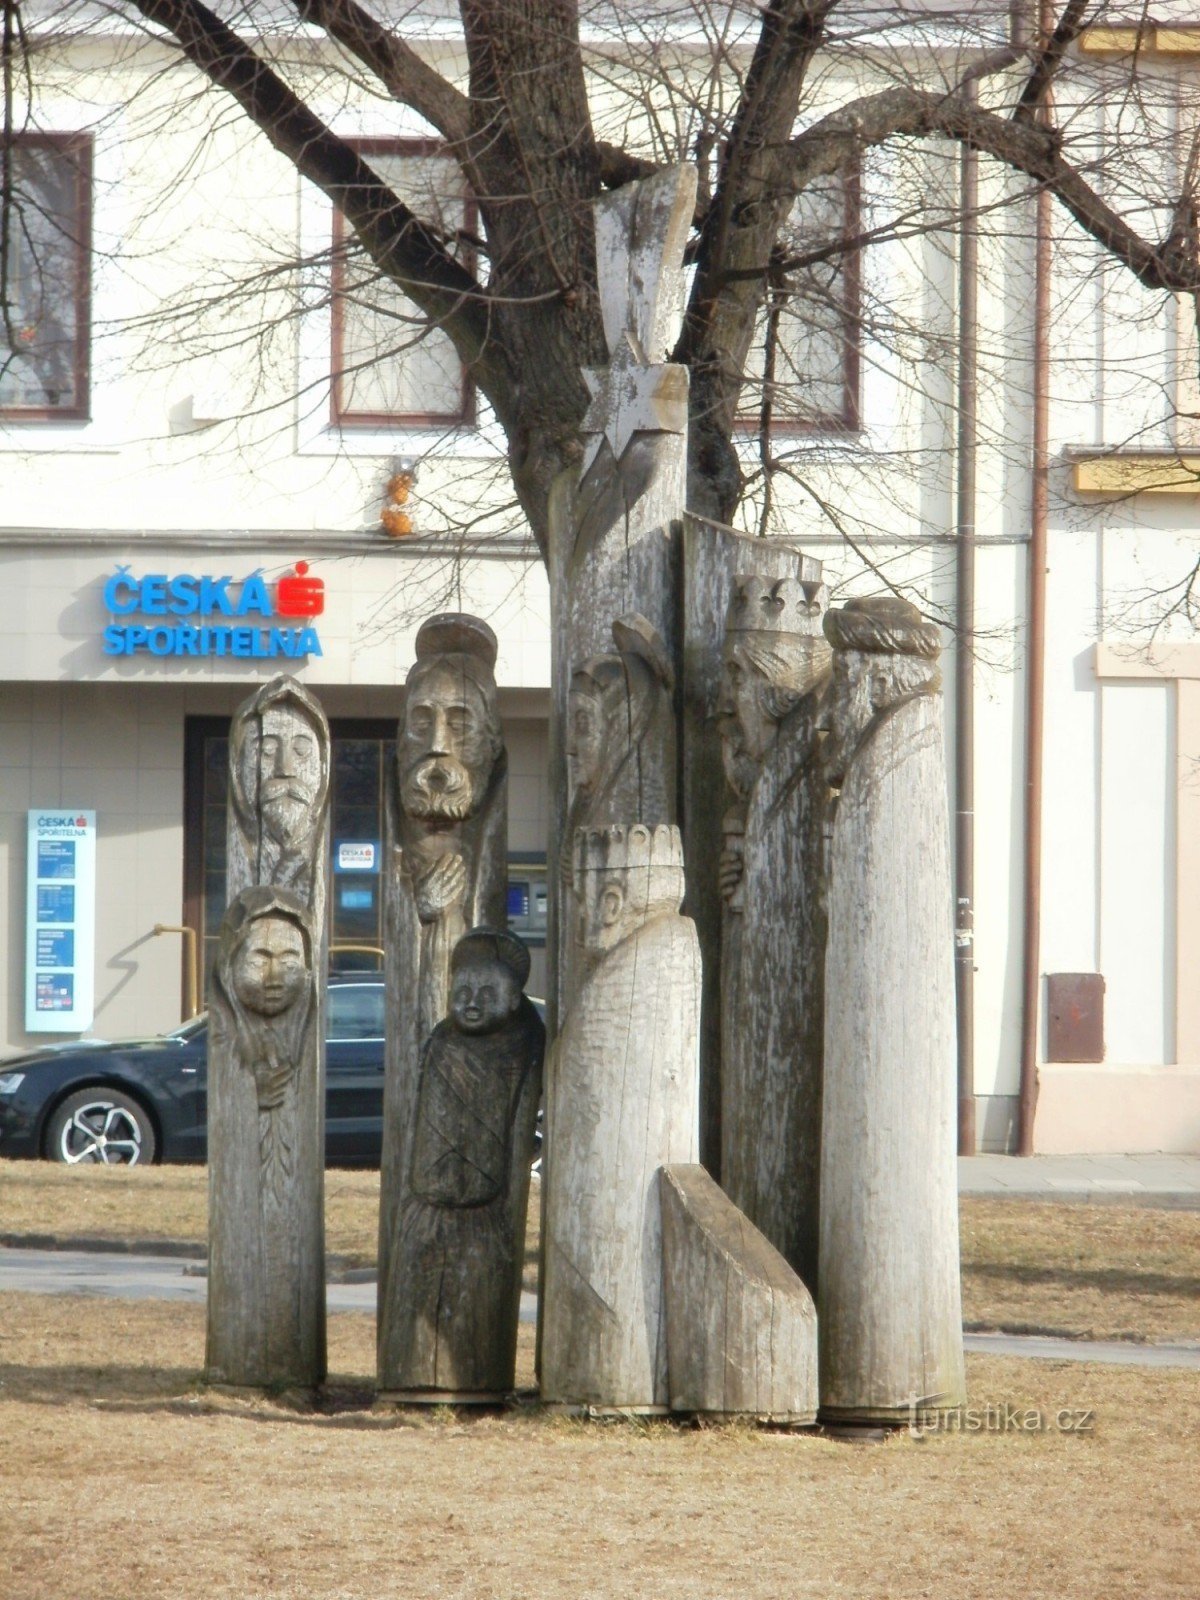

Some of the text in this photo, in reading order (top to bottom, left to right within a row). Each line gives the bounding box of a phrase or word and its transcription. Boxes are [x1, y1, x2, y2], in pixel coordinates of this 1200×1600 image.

[103, 564, 273, 617] ČESKÁ
[102, 619, 323, 657] SPOŘITELNA
[37, 815, 76, 827] ČESKÁ
